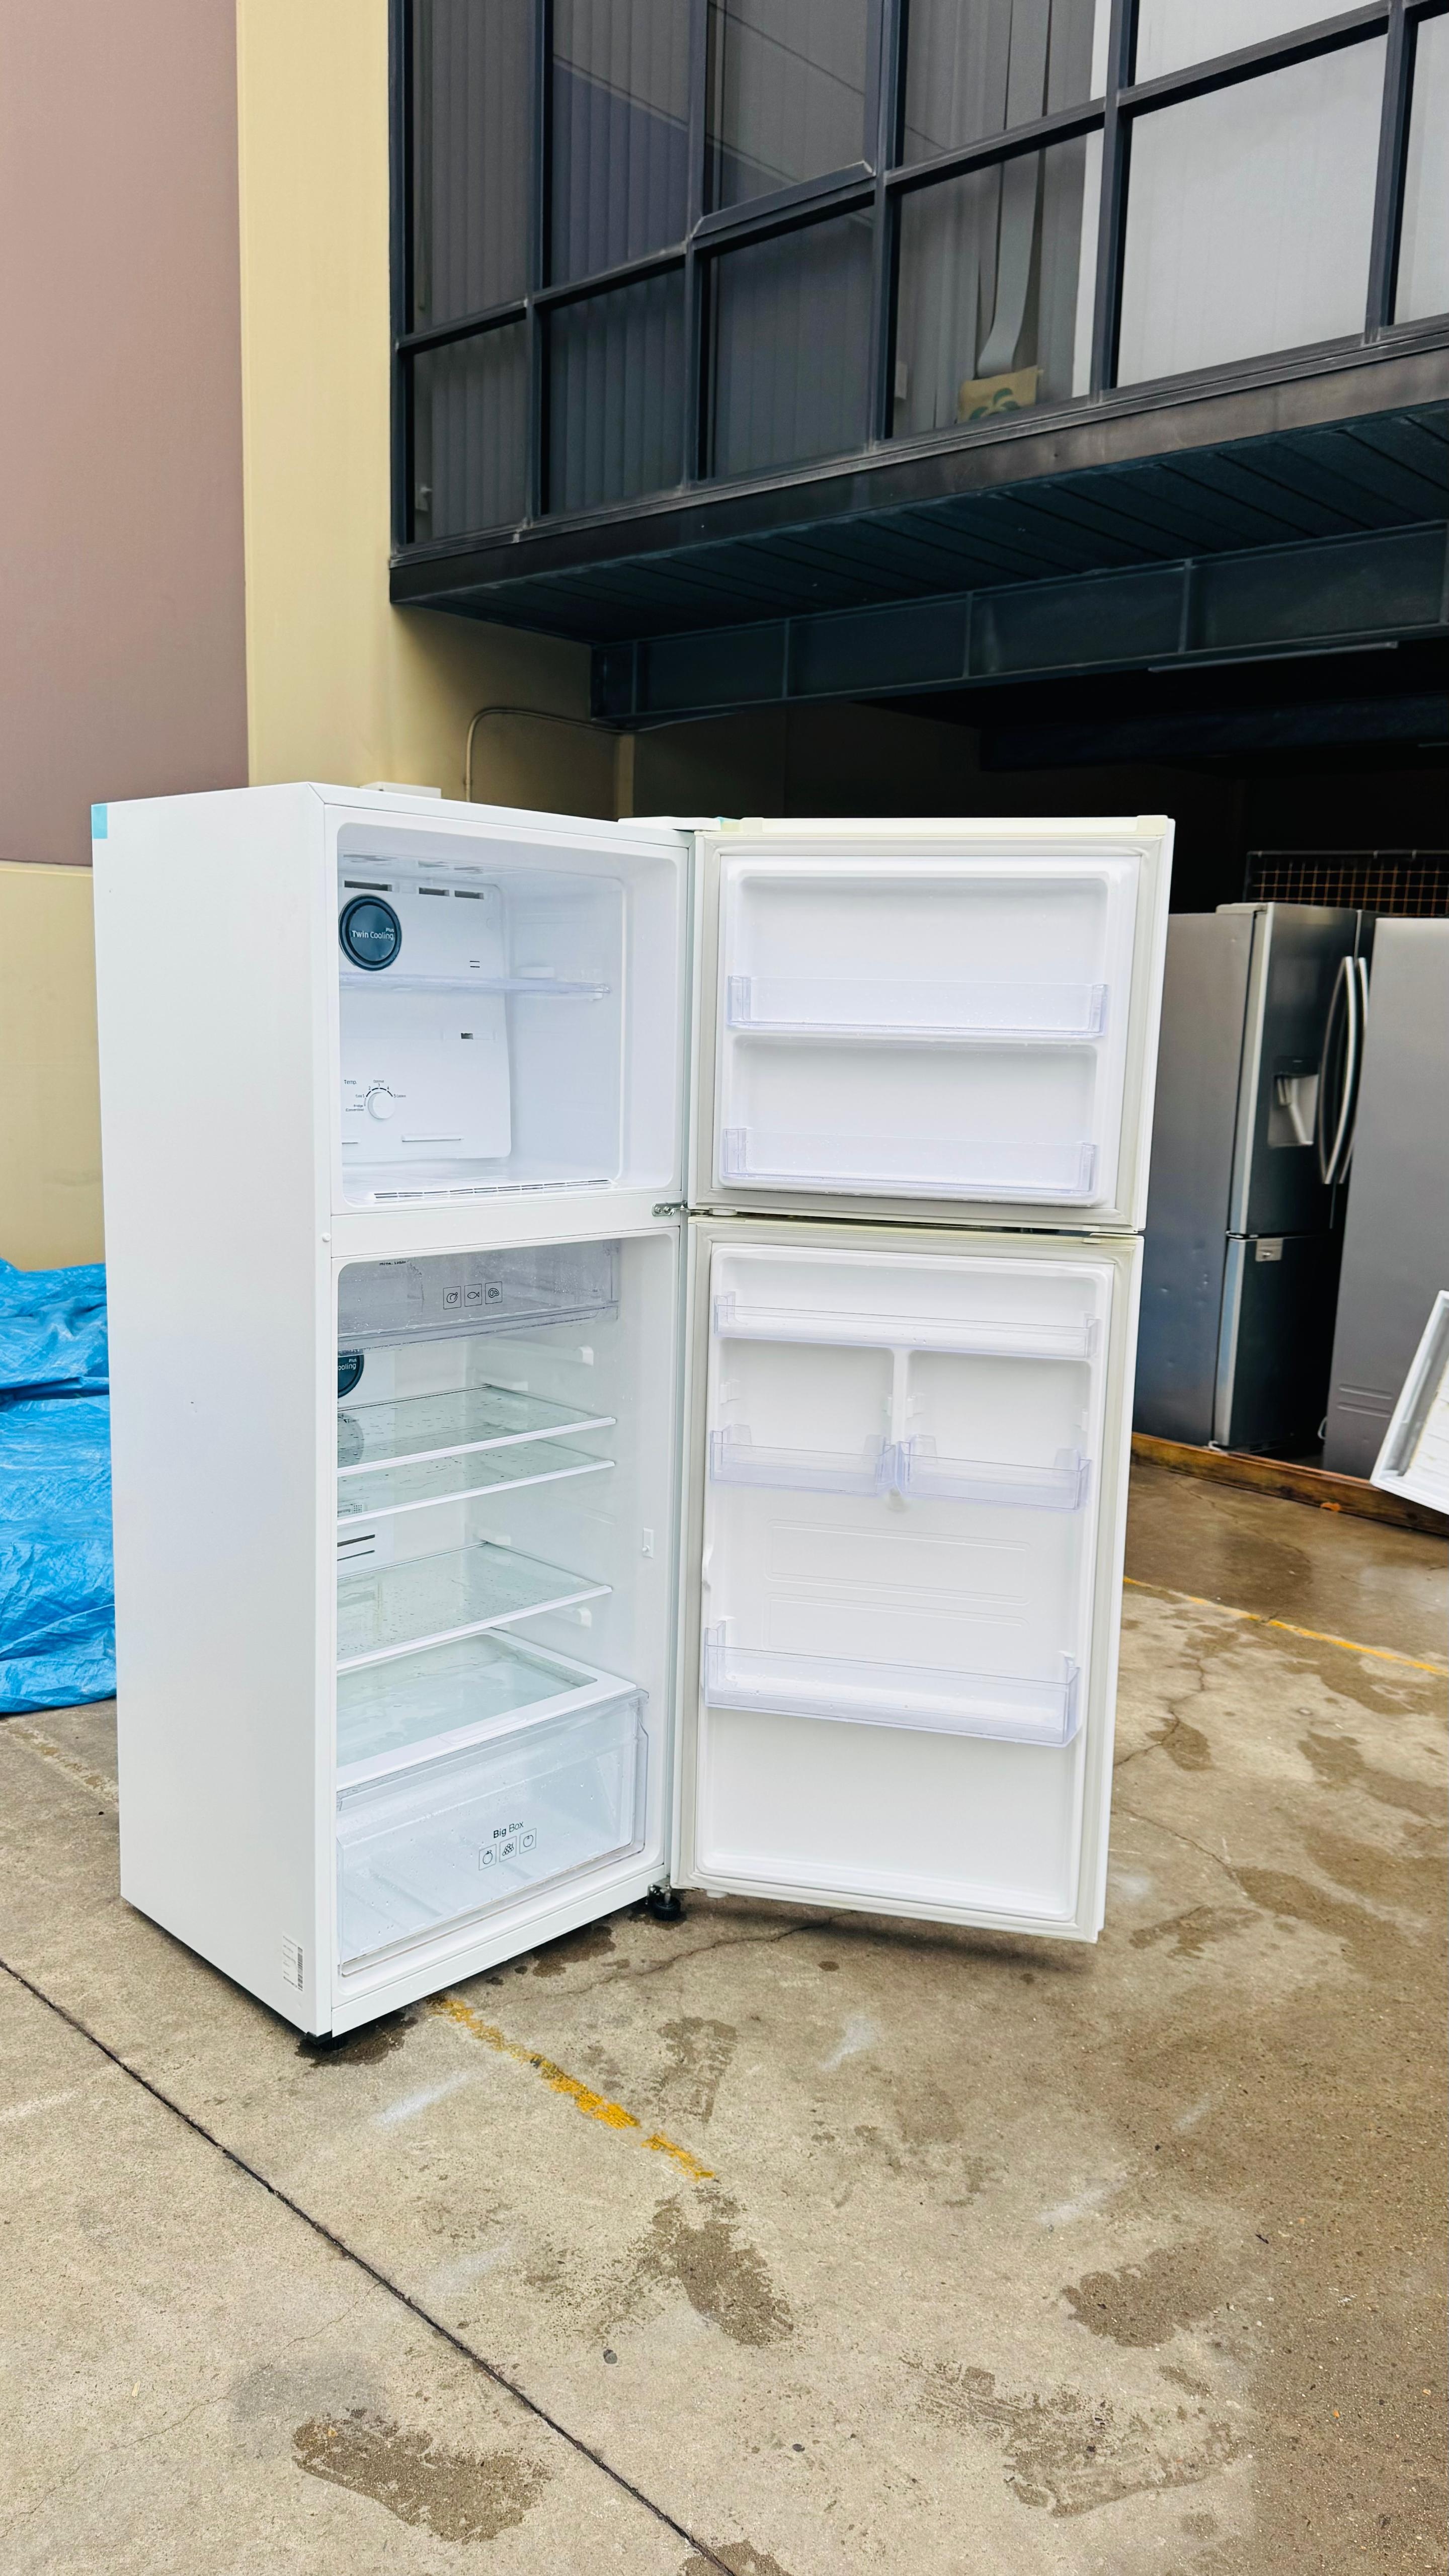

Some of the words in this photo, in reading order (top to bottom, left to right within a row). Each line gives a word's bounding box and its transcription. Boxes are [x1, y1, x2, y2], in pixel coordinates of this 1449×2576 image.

[352, 930, 369, 938] Twin
[370, 931, 394, 941] Cooling
[494, 1828, 506, 1838] Big
[509, 1822, 523, 1832] Box
